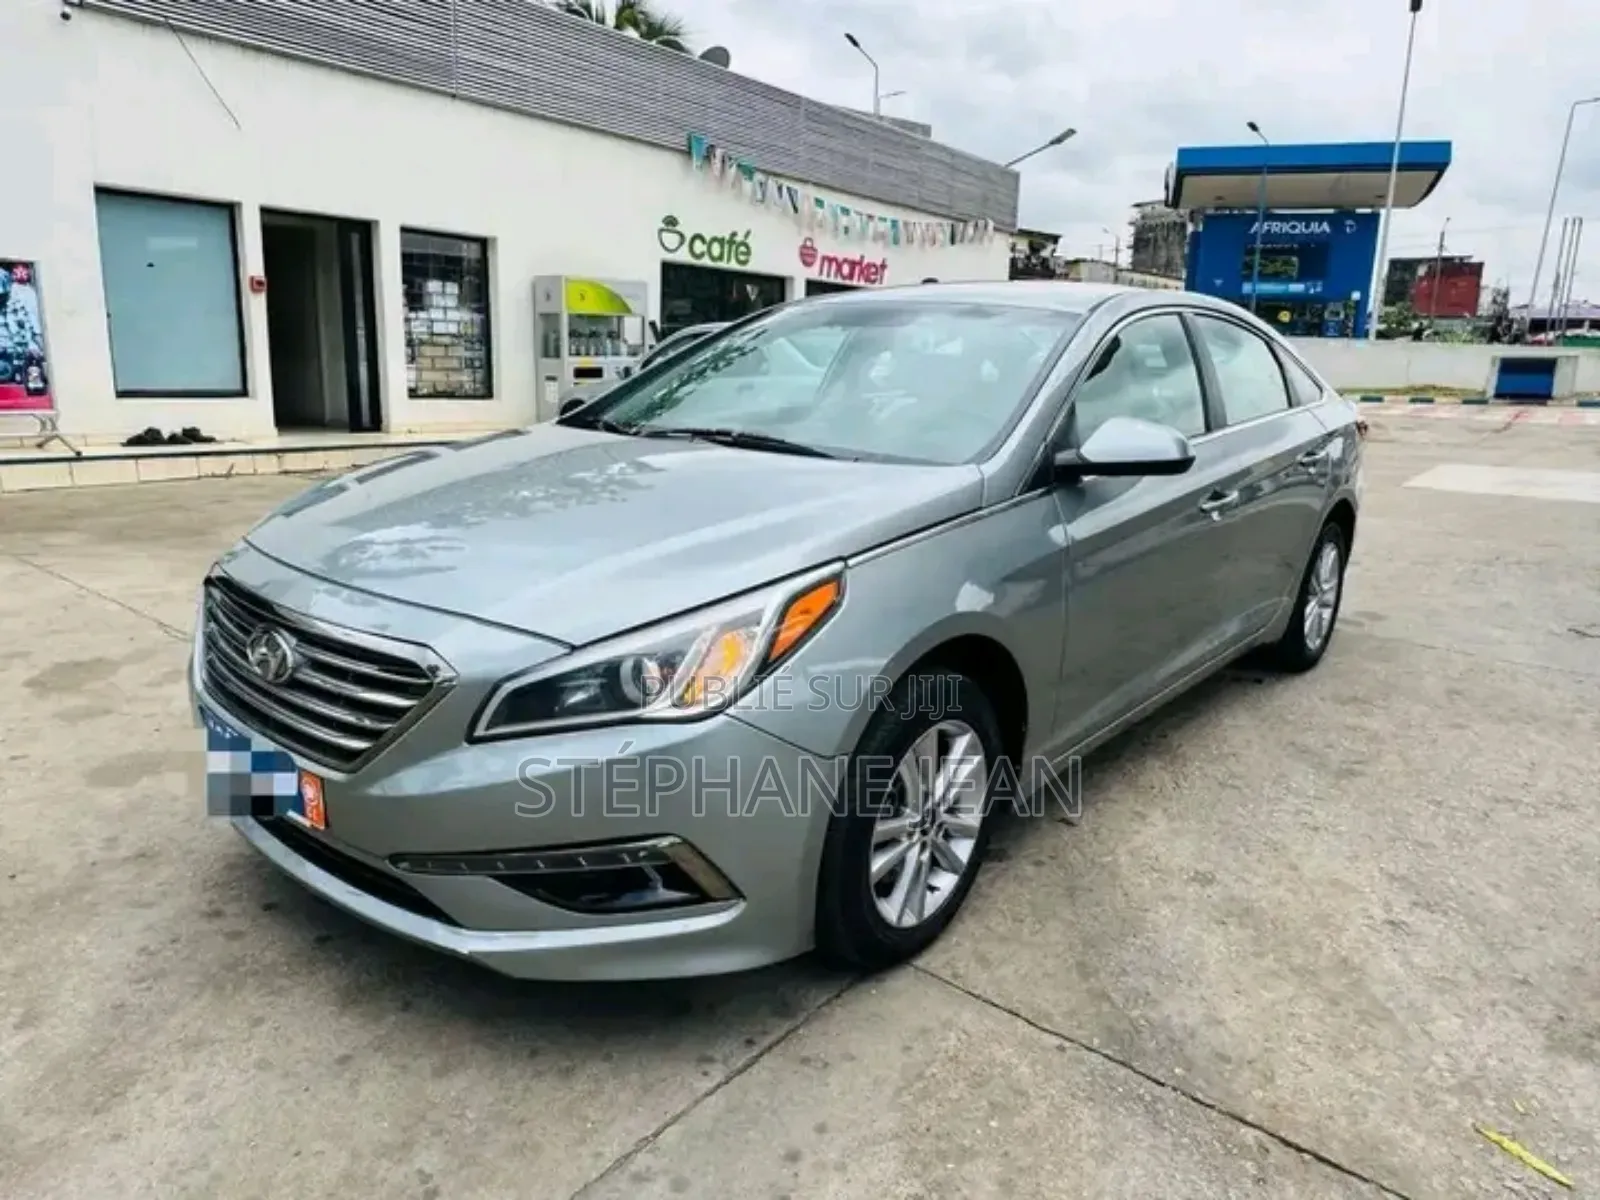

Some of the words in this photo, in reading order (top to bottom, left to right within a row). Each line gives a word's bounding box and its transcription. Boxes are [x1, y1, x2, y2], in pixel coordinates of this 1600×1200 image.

[1248, 221, 1331, 235] AFRIQUIA
[688, 229, 752, 267] café
[818, 254, 888, 285] market
